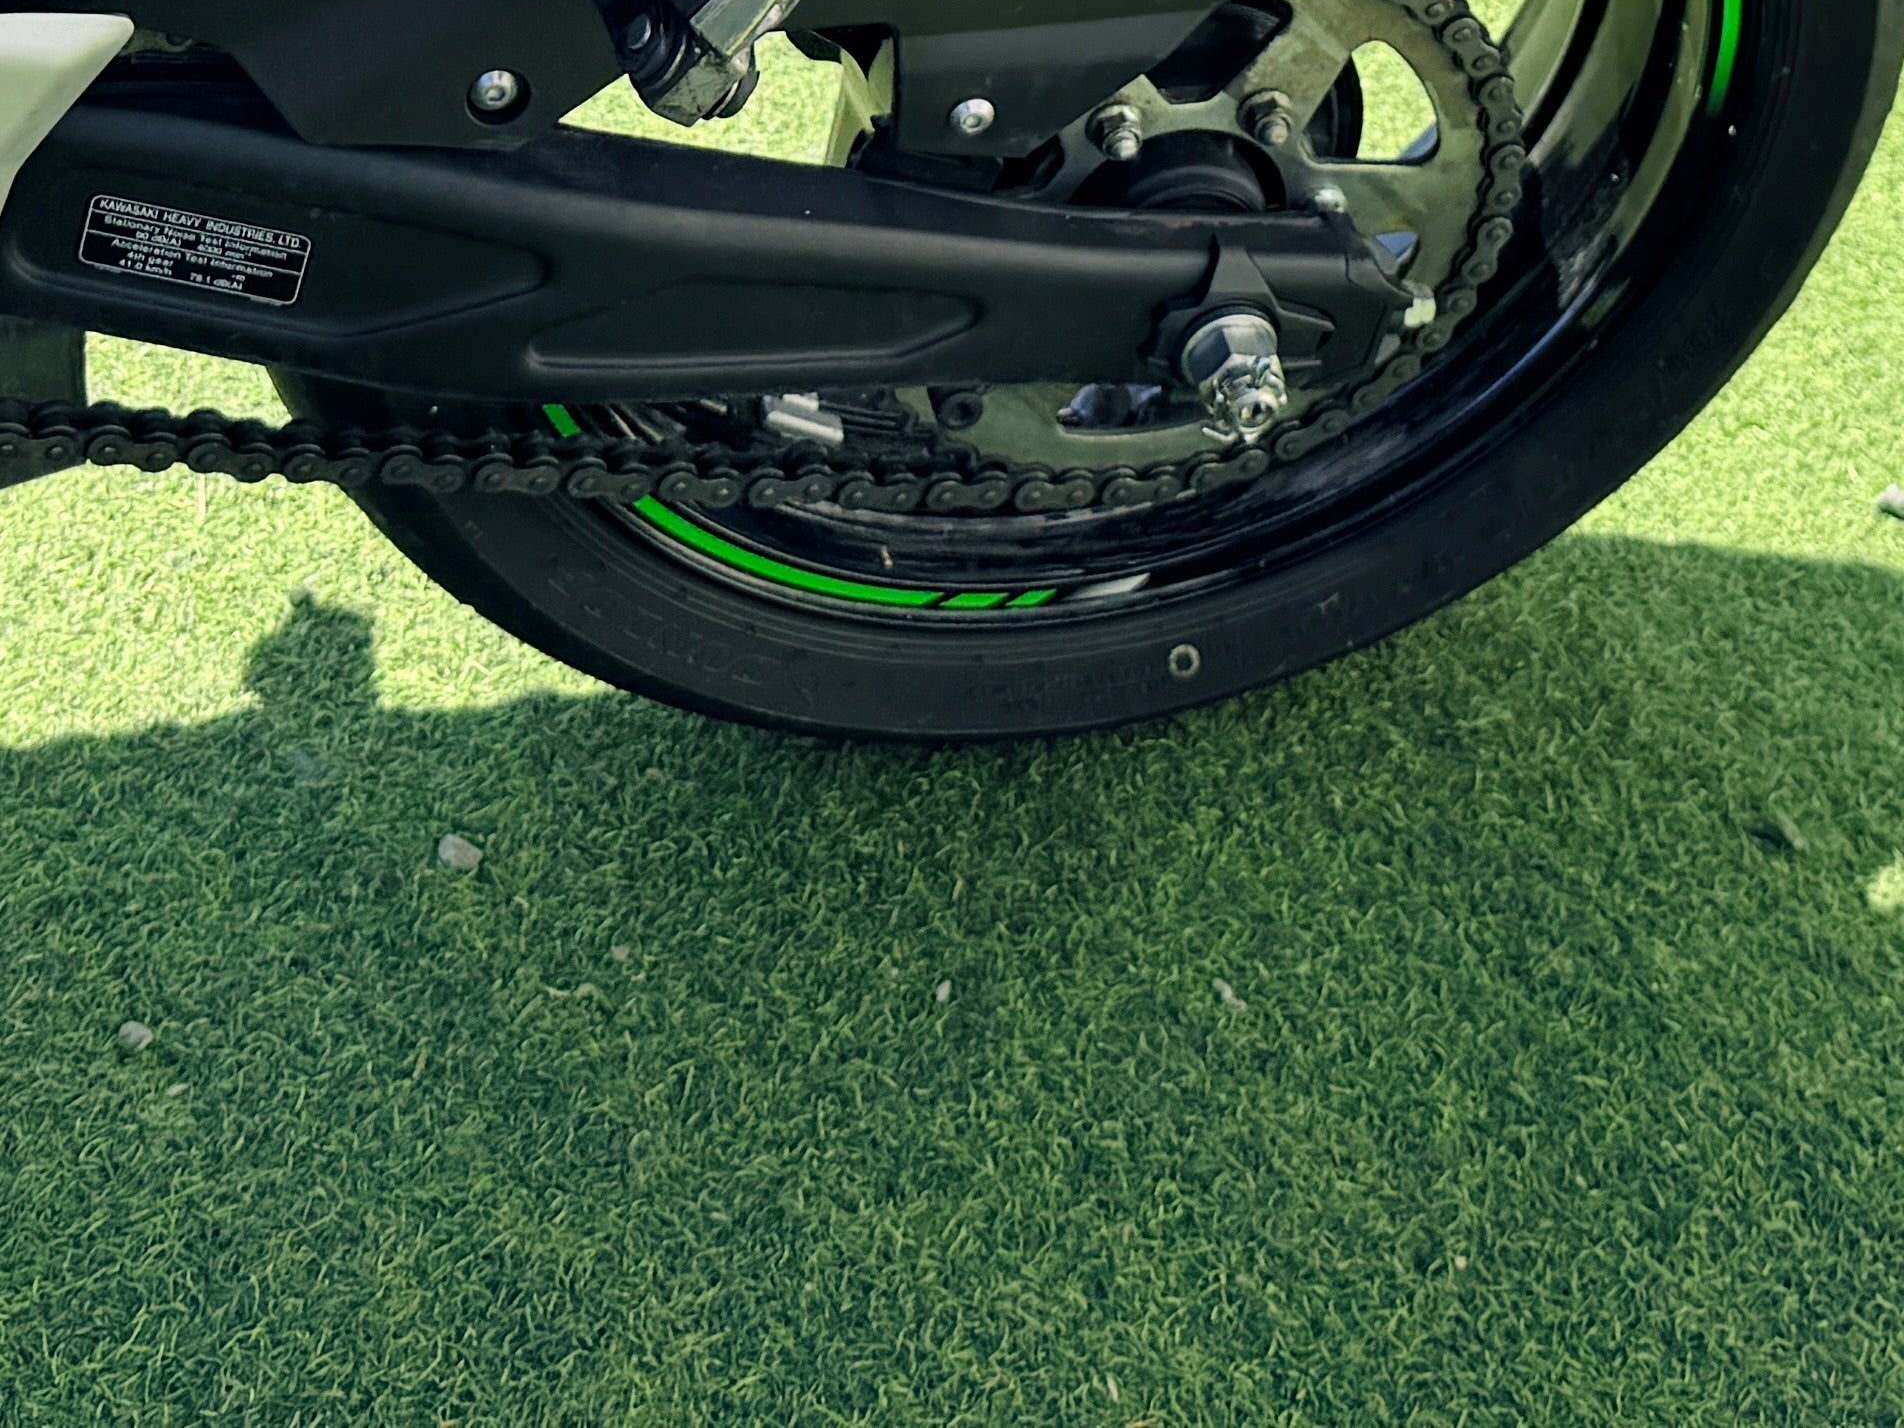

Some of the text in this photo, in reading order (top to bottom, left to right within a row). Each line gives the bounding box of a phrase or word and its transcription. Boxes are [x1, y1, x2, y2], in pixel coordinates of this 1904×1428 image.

[99, 199, 159, 220] KAWASAKI
[163, 211, 202, 228] HEAVY
[277, 236, 302, 249] LTD.
[103, 215, 161, 235] Stationary
[200, 234, 223, 247] Test
[224, 238, 288, 260] Information
[111, 238, 274, 278] Acceleration Test Information
